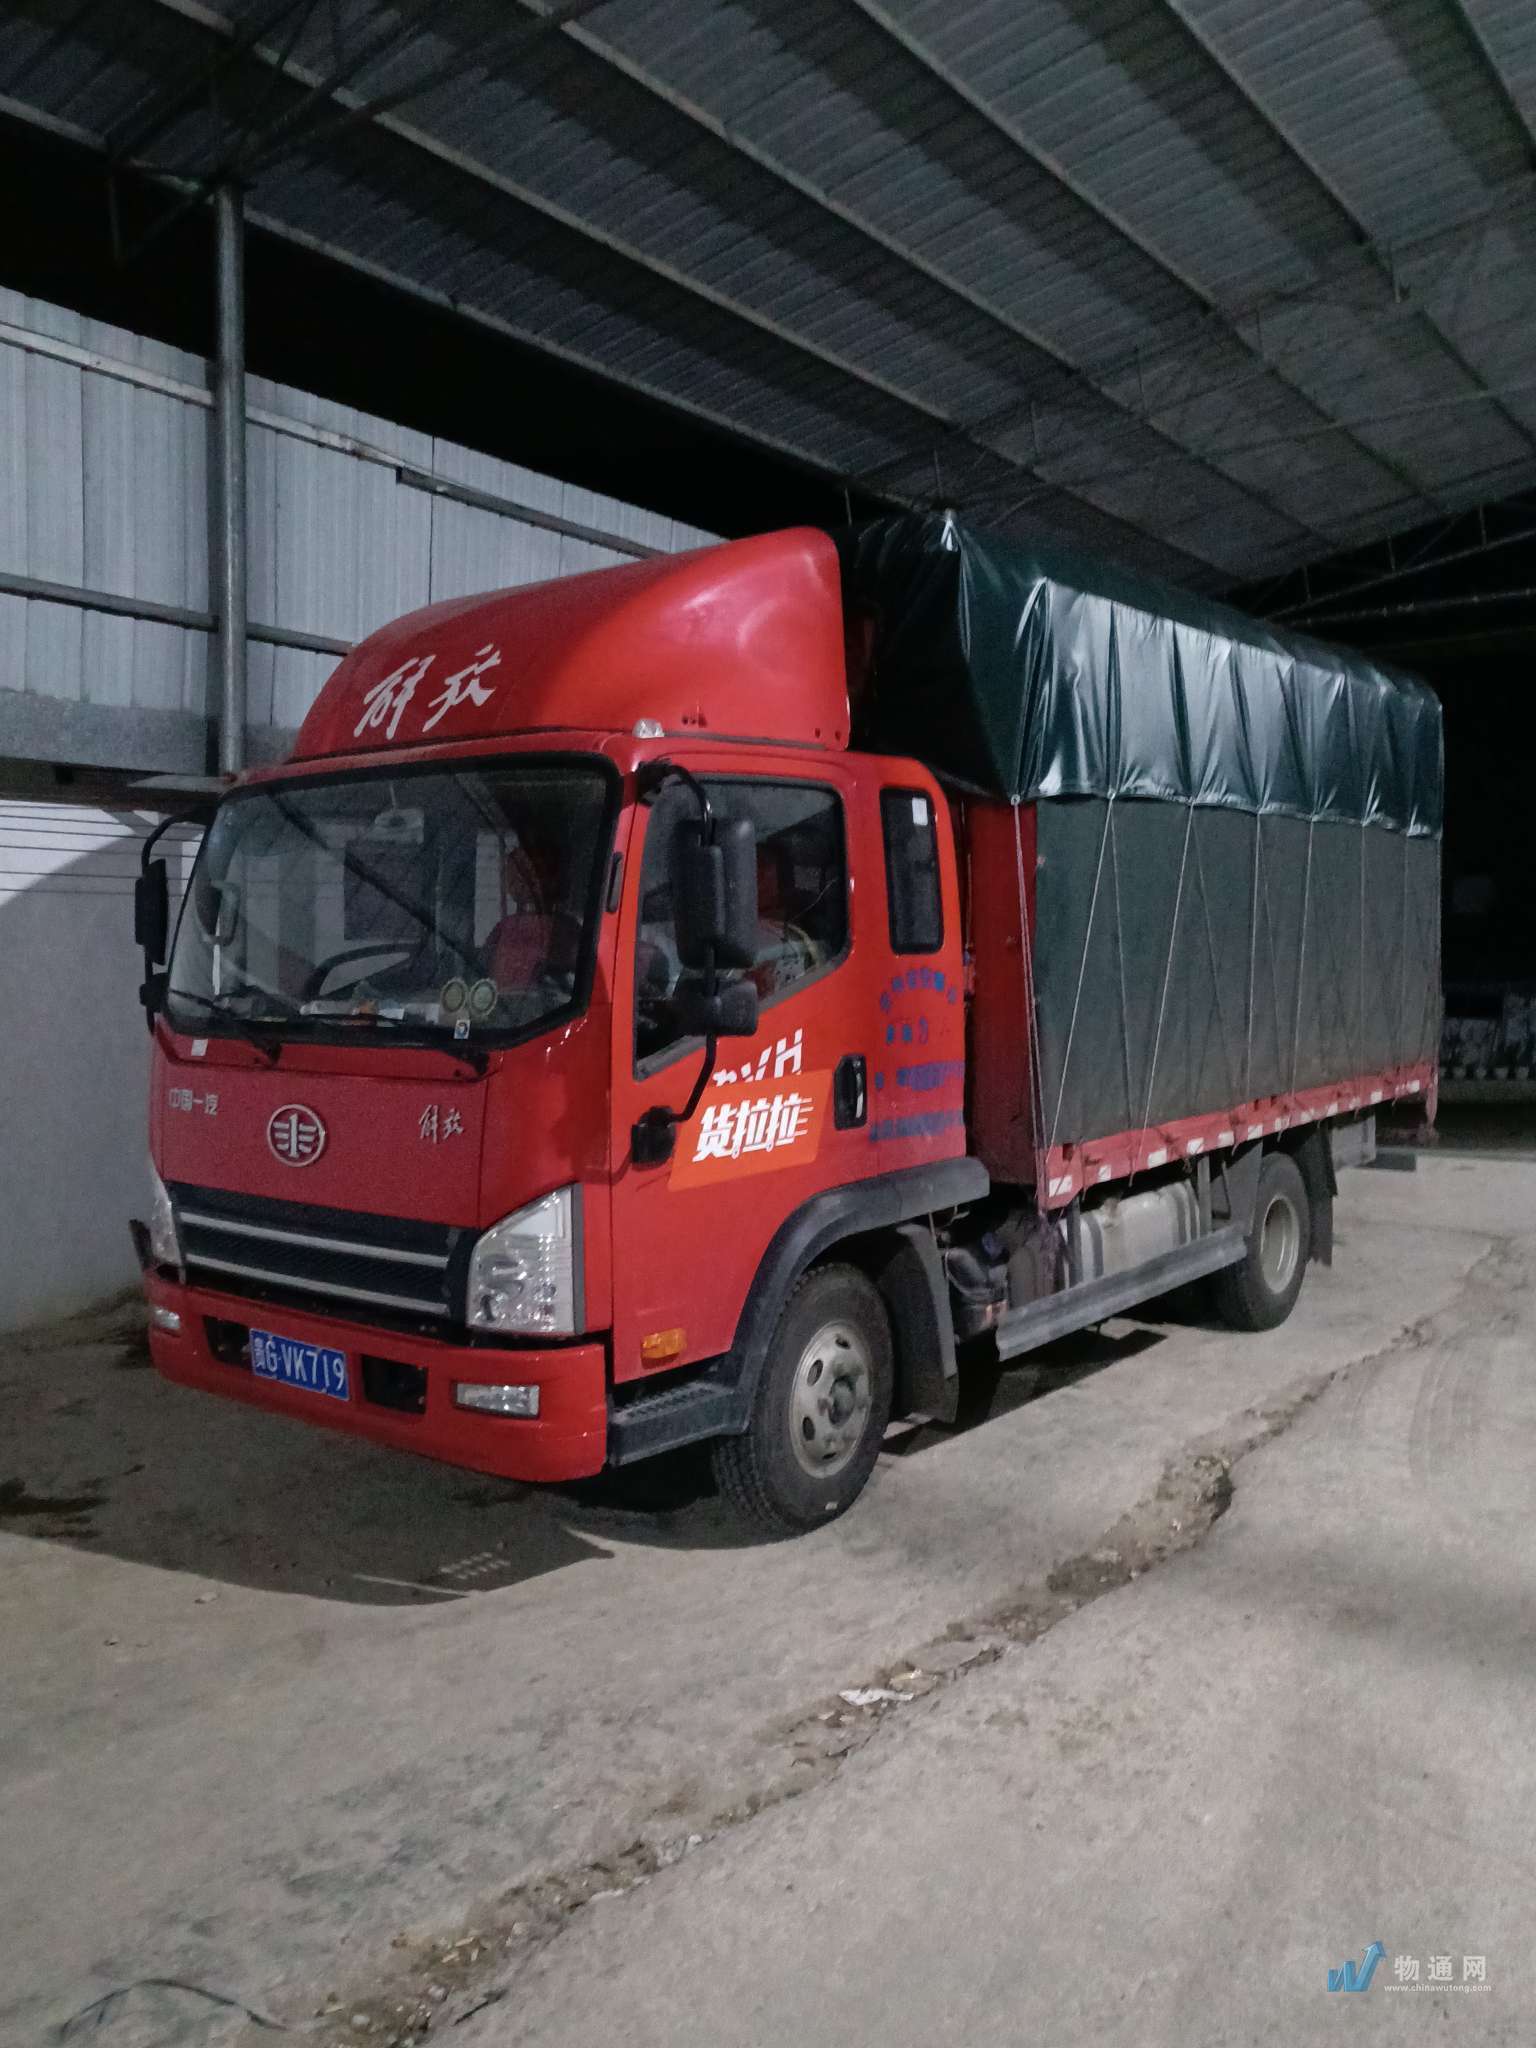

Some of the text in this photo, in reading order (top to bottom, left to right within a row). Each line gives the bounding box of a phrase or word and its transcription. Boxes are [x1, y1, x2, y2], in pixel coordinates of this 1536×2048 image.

[169, 1088, 218, 1116] 中国一汽
[692, 1092, 814, 1162] 货拉拉
